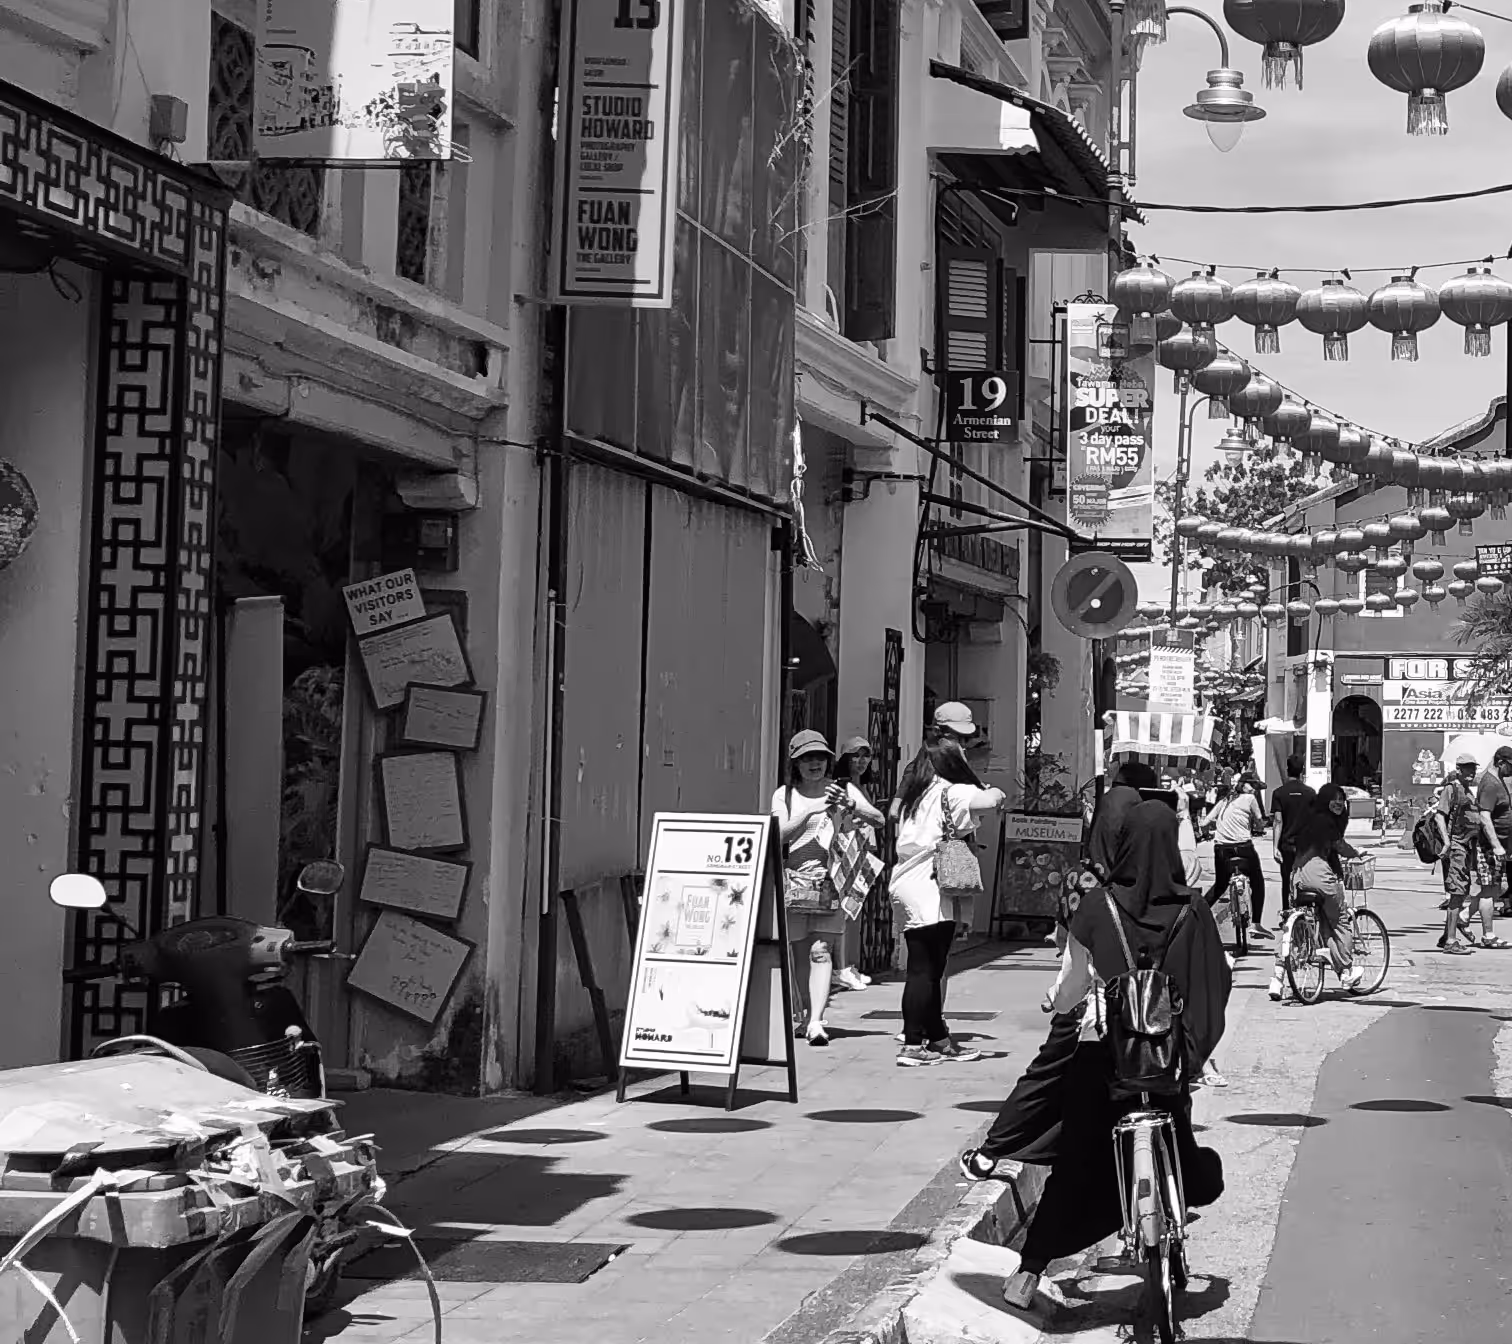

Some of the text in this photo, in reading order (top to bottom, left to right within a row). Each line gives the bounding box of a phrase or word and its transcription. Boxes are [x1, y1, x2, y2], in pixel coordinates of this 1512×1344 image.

[582, 95, 642, 117] STUDIO
[581, 117, 655, 140] HOWARD
[578, 199, 631, 225] FUAN
[578, 225, 638, 252] WONG
[958, 376, 1007, 412] 19
[1075, 387, 1150, 408] SUPER
[952, 413, 1012, 426] Armenian
[1085, 407, 1140, 424] DEAL!
[963, 426, 1000, 439] Street
[1100, 424, 1122, 434] your
[1079, 432, 1145, 448] 3 day pass
[1086, 447, 1139, 465] RM55
[1072, 494, 1086, 505] 50
[346, 573, 414, 601] WHAT OUR
[354, 588, 414, 614] VISITORS
[369, 609, 393, 626] SAY
[1389, 659, 1449, 680] FOR
[1393, 708, 1420, 720] 2277
[1424, 708, 1443, 720] 222
[1015, 827, 1065, 839] MUSEUM
[706, 836, 754, 864] NO. 13
[686, 894, 710, 909] FUAN
[684, 910, 711, 924] WONG
